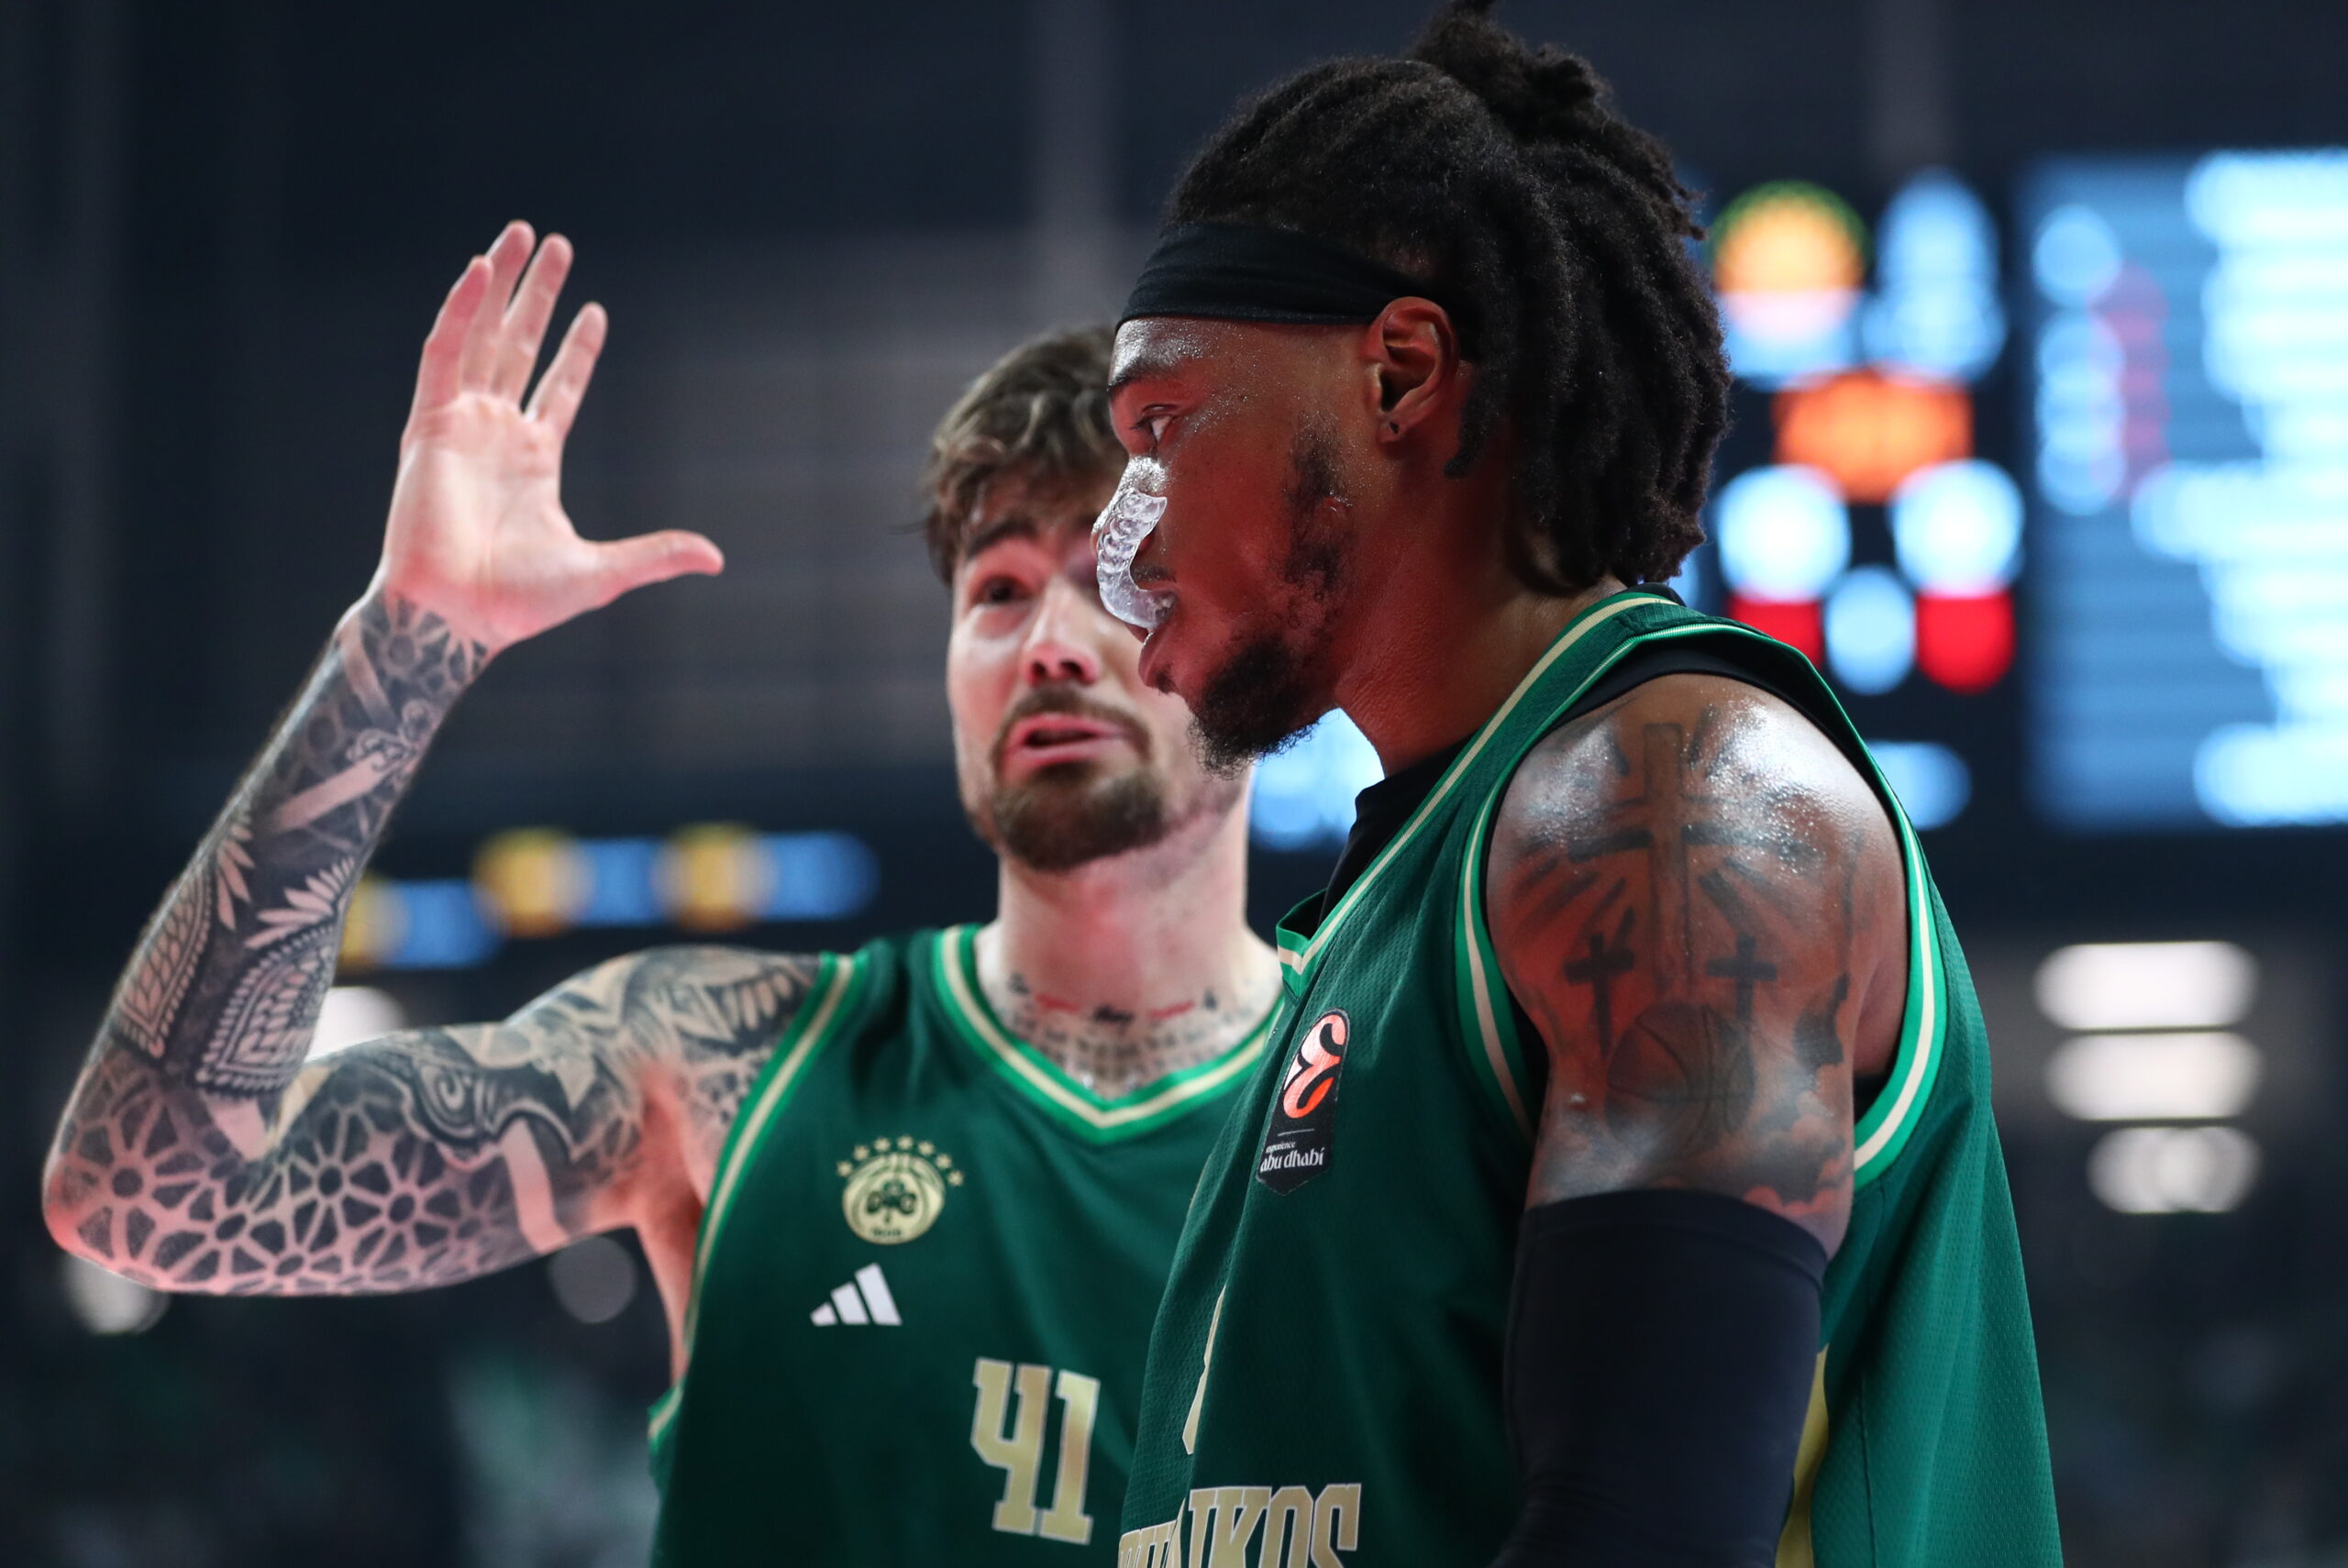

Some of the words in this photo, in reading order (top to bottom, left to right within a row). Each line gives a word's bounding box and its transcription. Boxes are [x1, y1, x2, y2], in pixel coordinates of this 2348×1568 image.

[1259, 1154, 1283, 1173] abu
[1284, 1147, 1325, 1168] dhabi
[969, 1356, 1101, 1546] 41
